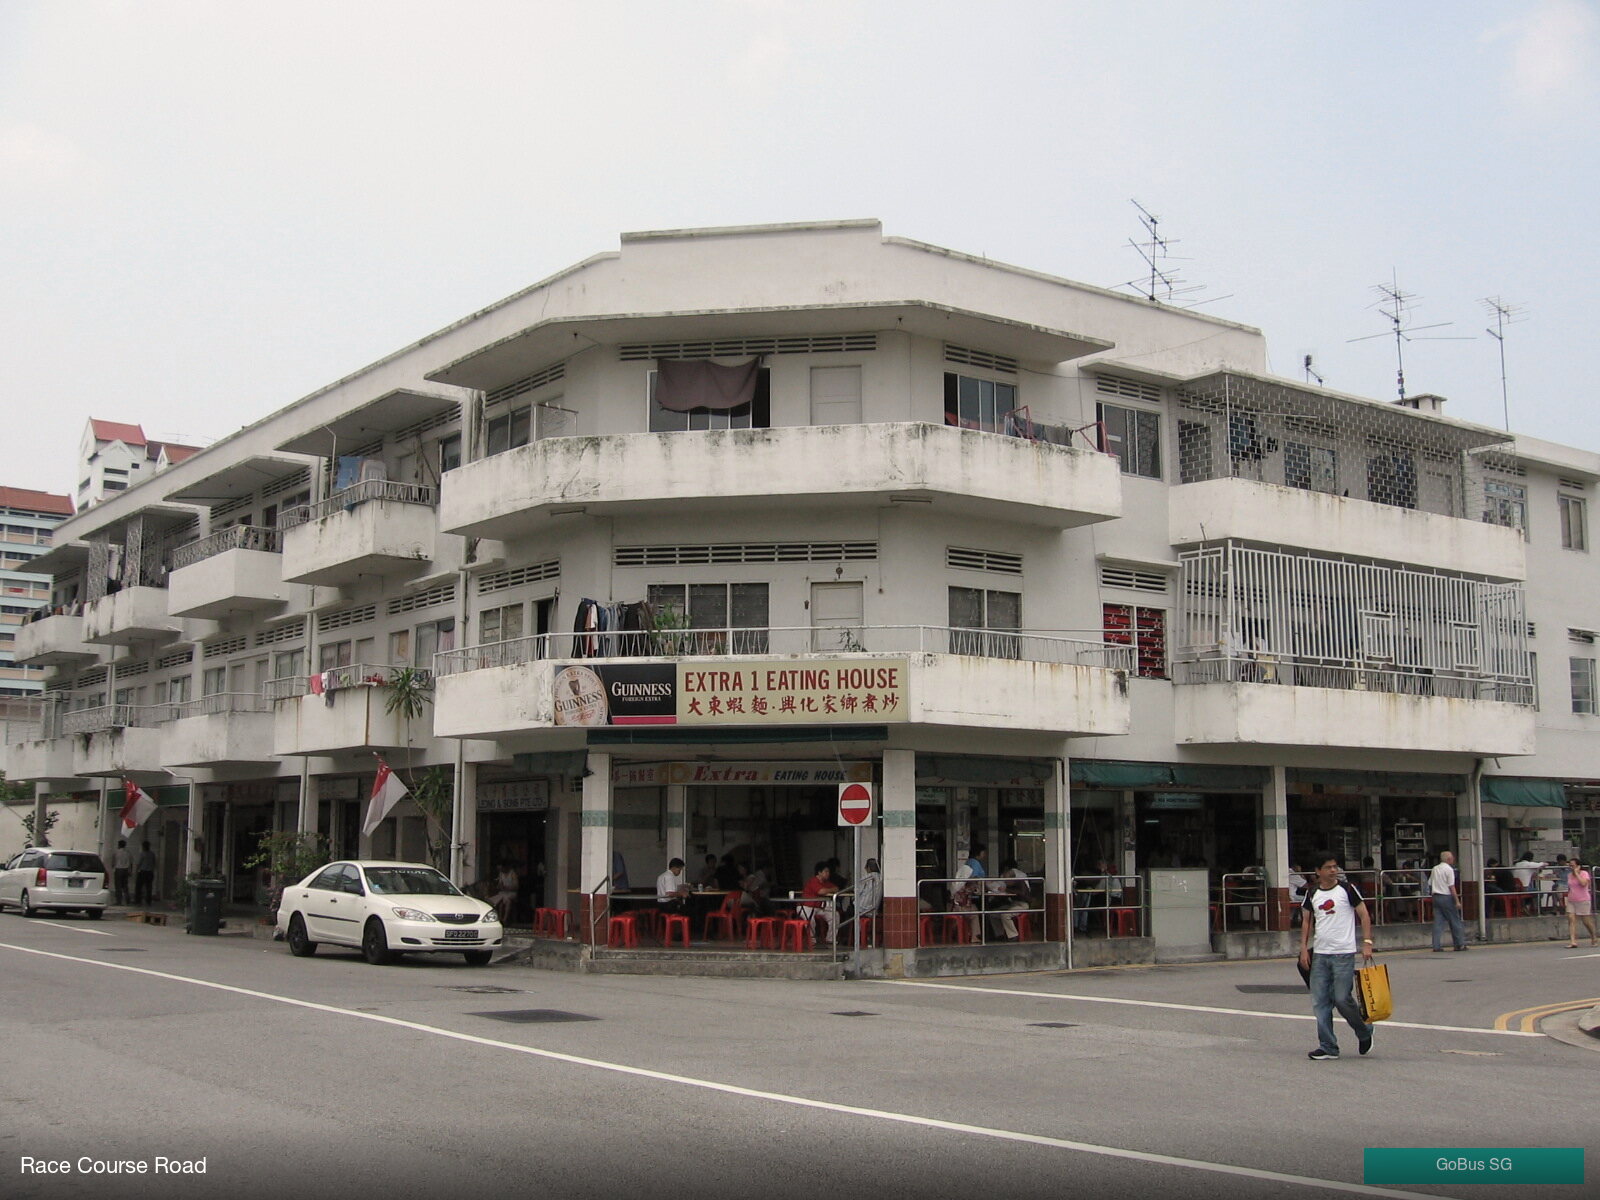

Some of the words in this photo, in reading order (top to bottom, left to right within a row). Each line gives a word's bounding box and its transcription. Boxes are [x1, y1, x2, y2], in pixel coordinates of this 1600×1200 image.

[611, 681, 672, 697] GUINNESS
[685, 671, 743, 692] EXTRA
[751, 670, 759, 691] 1
[766, 669, 830, 691] EATING
[837, 668, 898, 690] HOUSE
[554, 689, 603, 713] GUINNESS
[693, 764, 759, 781] Extra
[774, 770, 809, 781] EATING
[814, 770, 847, 781] HOUSE
[1363, 973, 1377, 1012] FLUKE
